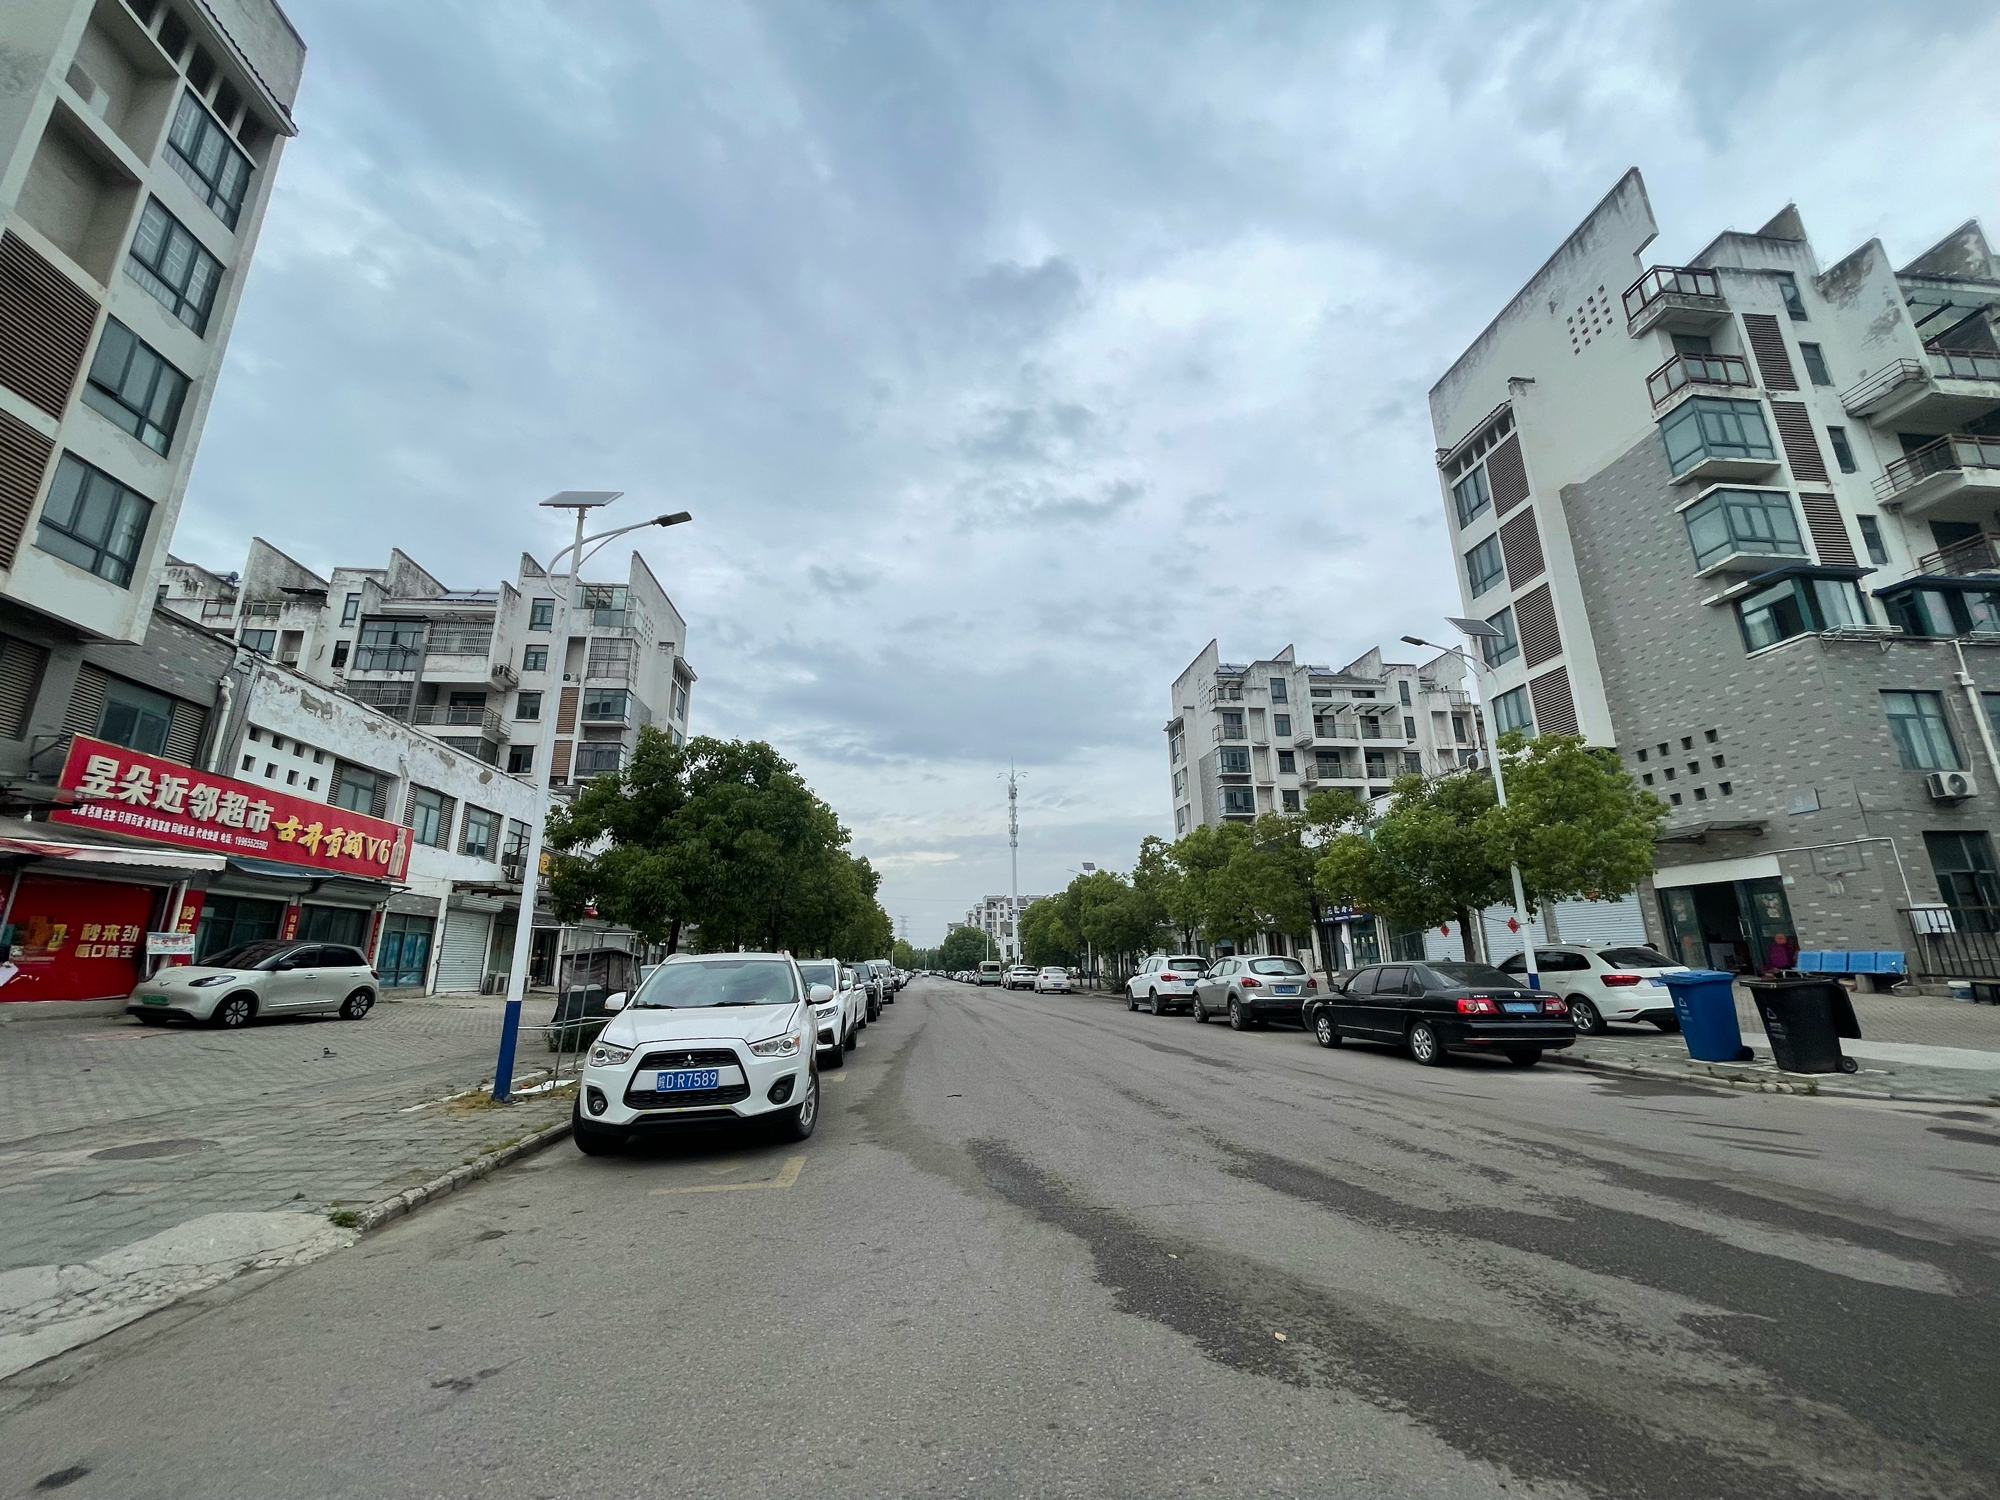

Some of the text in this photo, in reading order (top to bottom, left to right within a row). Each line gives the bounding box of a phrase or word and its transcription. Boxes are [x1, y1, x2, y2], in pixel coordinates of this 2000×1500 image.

[75, 754, 275, 834] 昱朵近邻超市
[102, 809, 117, 822] 名茶
[118, 811, 145, 827] 日用百货
[170, 821, 195, 837] 回收礼品
[196, 828, 219, 842] 代收快递
[80, 923, 140, 942] 秒来劲
